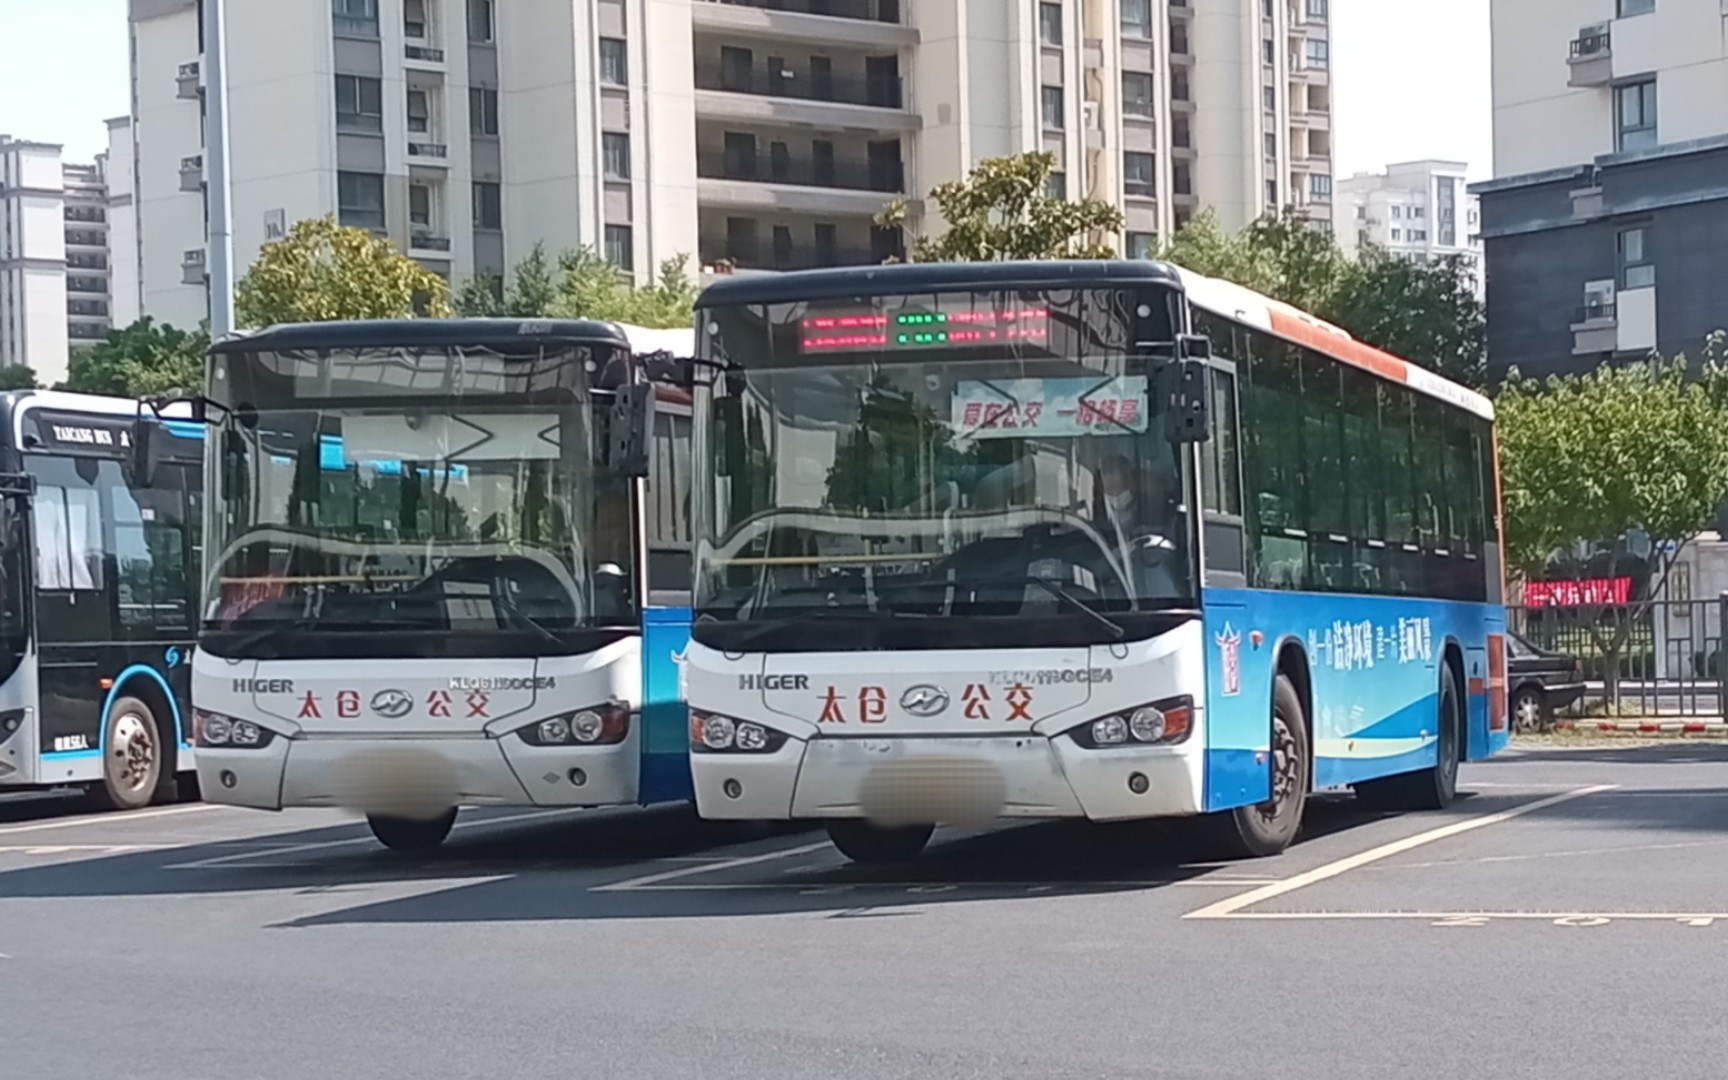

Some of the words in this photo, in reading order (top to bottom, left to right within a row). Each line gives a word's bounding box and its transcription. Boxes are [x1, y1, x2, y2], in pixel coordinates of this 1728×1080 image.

[233, 679, 294, 693] HIGER
[739, 674, 809, 690] HIGER
[297, 690, 361, 718] 太仓
[426, 689, 490, 718] 公交
[816, 686, 887, 723] 太仓
[961, 683, 1034, 721] 公交
